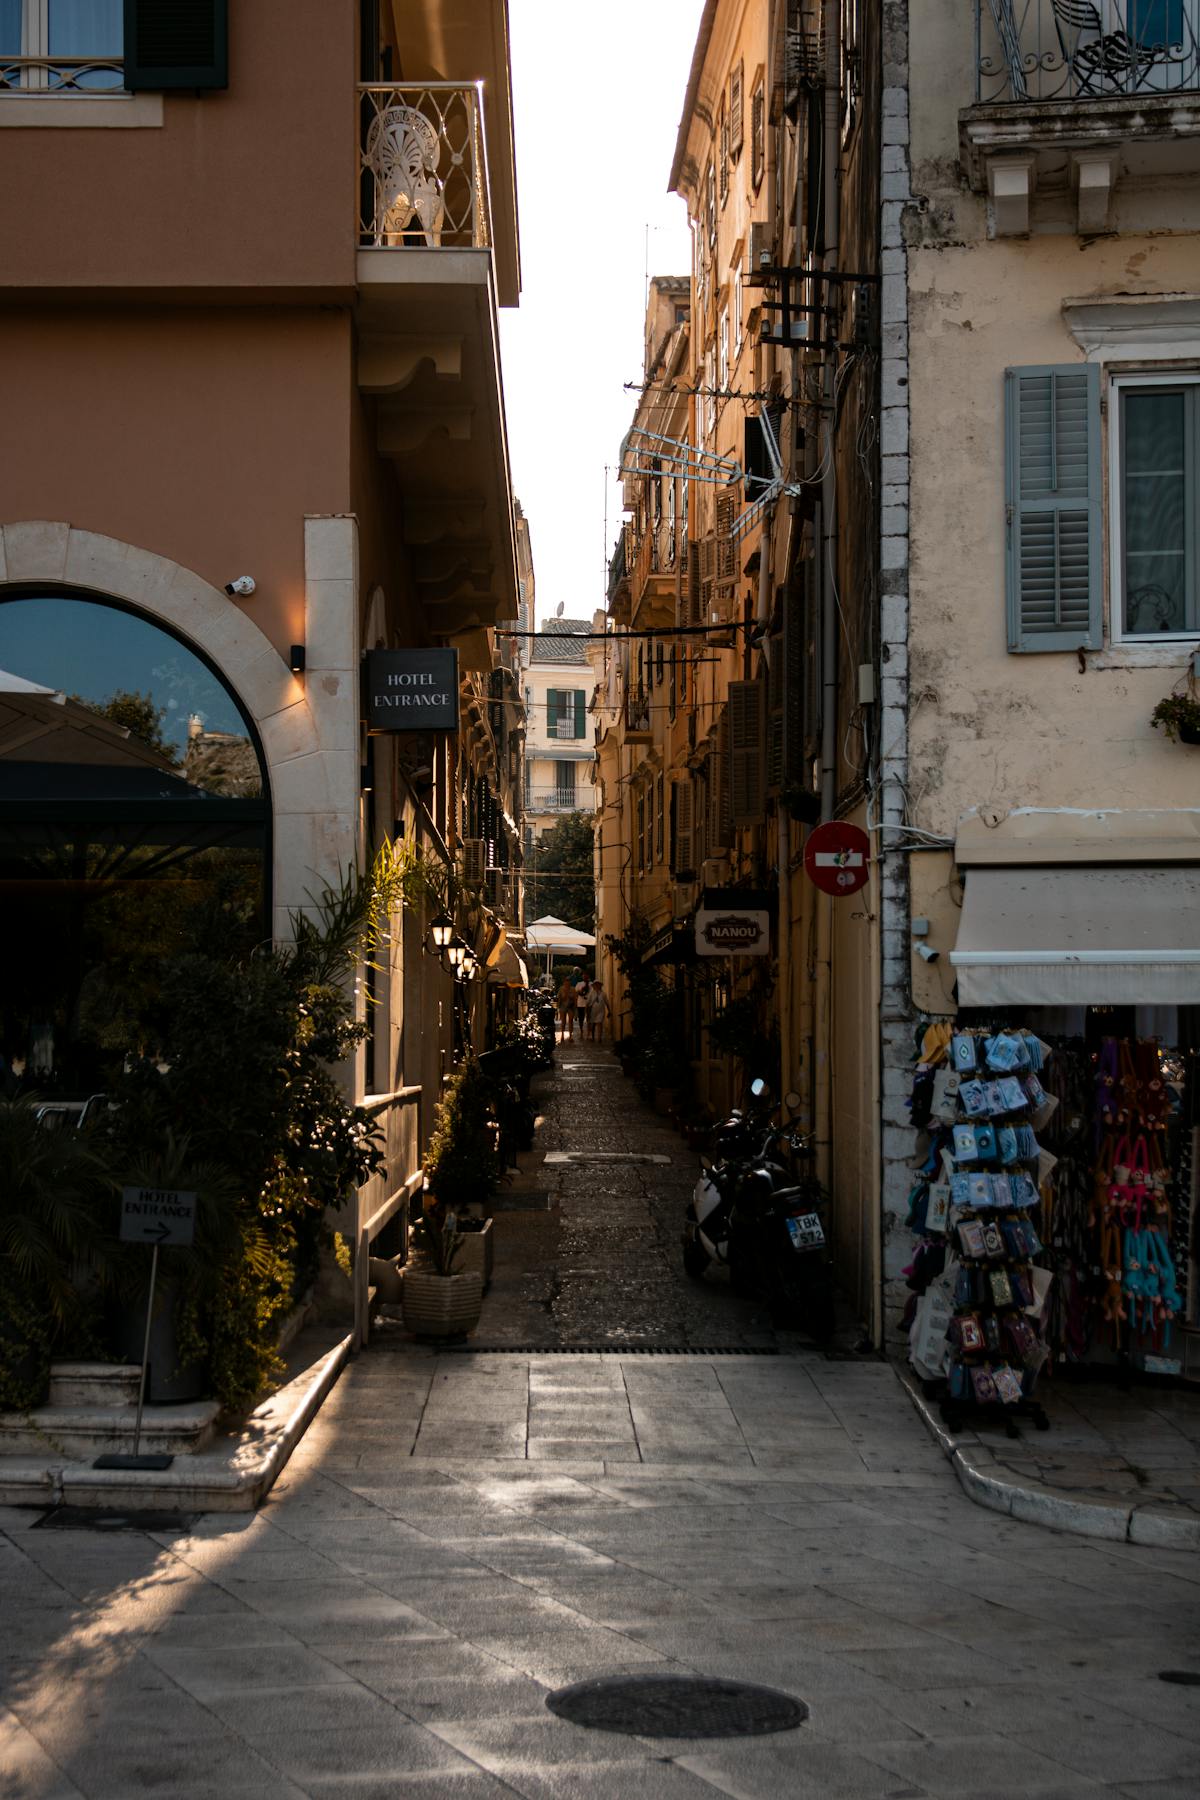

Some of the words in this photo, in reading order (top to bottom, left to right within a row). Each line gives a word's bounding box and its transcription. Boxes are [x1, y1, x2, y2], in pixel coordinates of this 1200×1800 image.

[387, 673, 437, 686] HOTEL
[374, 693, 450, 707] ENTRANCE
[711, 927, 757, 937] NANOU
[139, 1191, 182, 1205] HOTEL
[125, 1202, 193, 1217] ENTRANCE
